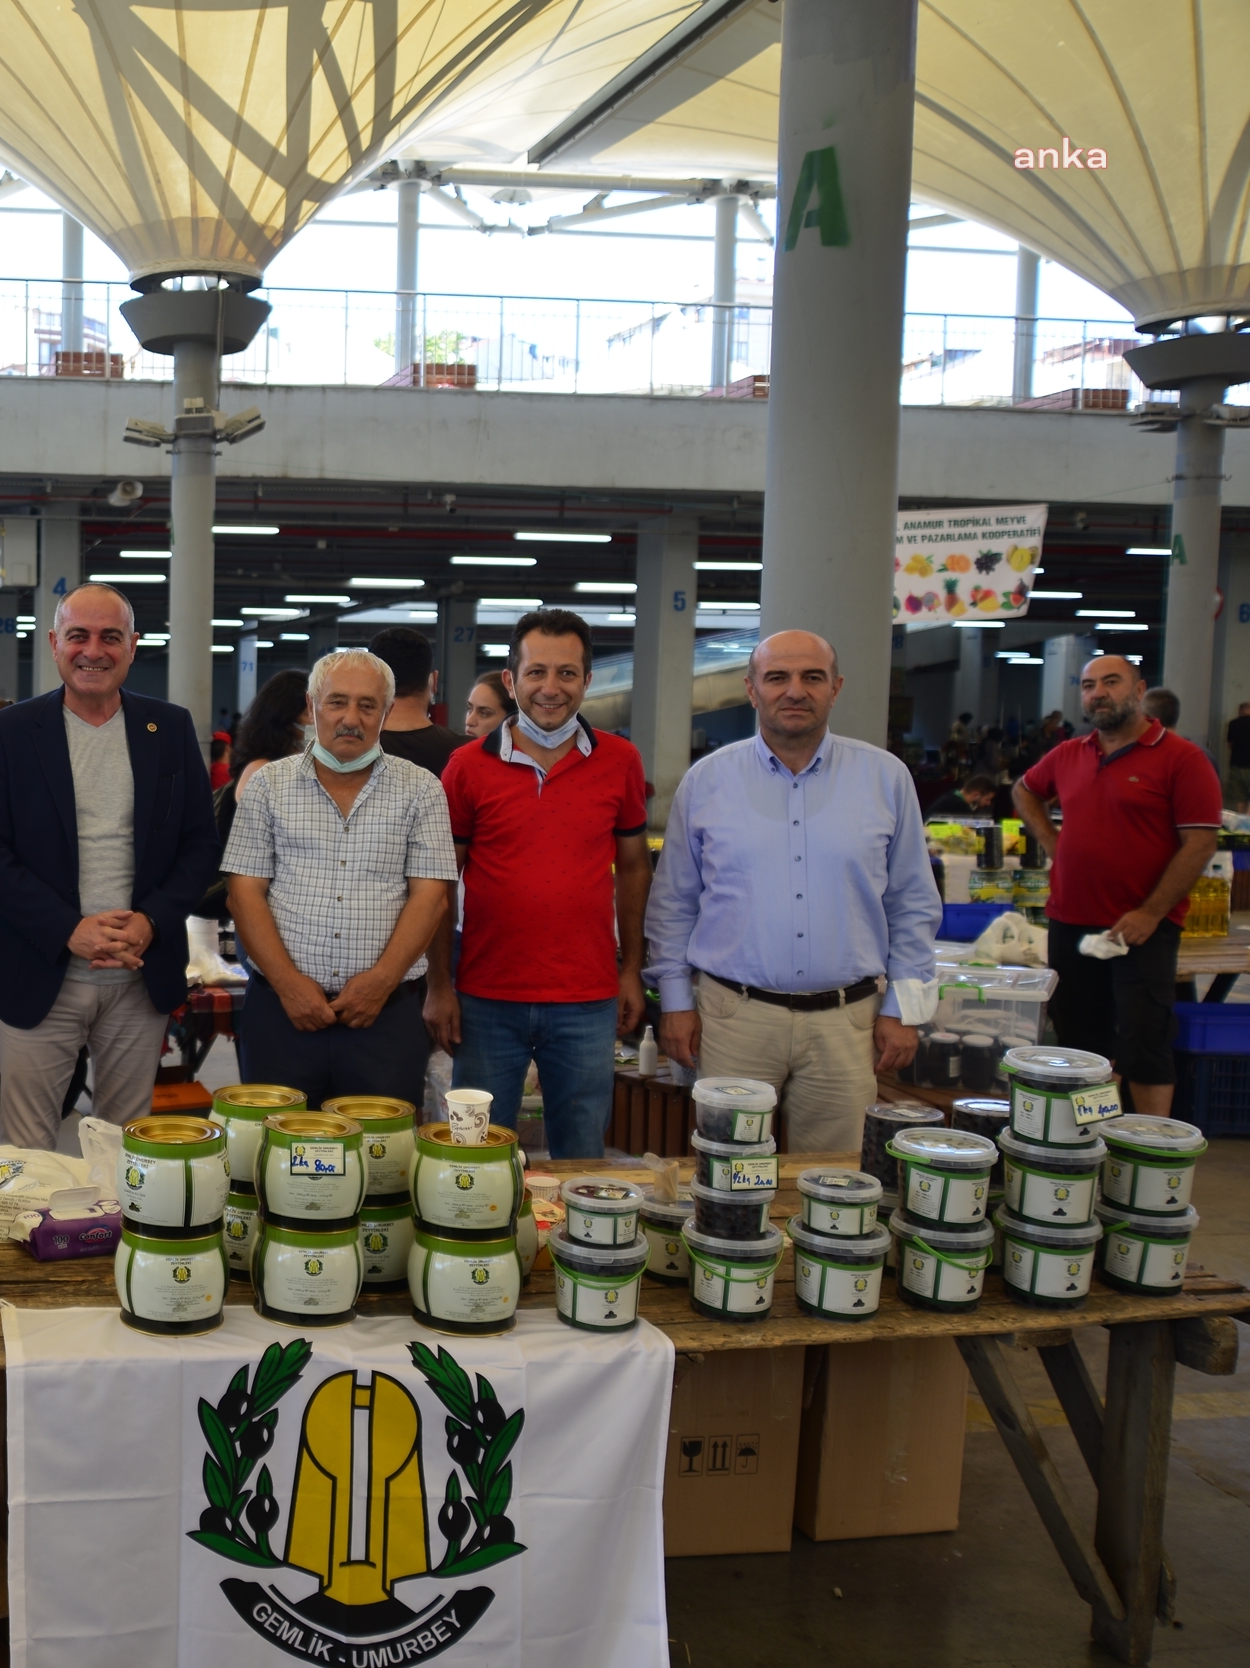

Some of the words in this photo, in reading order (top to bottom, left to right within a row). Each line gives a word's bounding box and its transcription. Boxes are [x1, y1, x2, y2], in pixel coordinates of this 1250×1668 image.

[784, 146, 850, 252] A
[903, 520, 945, 531] ANAMUR
[947, 516, 993, 528] TROPİKAL
[995, 515, 1028, 526] MEYVE
[907, 535, 919, 545] VE
[921, 532, 979, 544] PAZARLAMA
[981, 526, 1041, 539] KOOPERATİFİ
[53, 578, 67, 595] 4
[673, 590, 686, 612] 5
[453, 626, 476, 643] 27
[53, 1235, 70, 1245] 100
[79, 1230, 113, 1240] Confort
[252, 1602, 334, 1662] GEMLİK
[352, 1609, 462, 1668] UMURBEY
